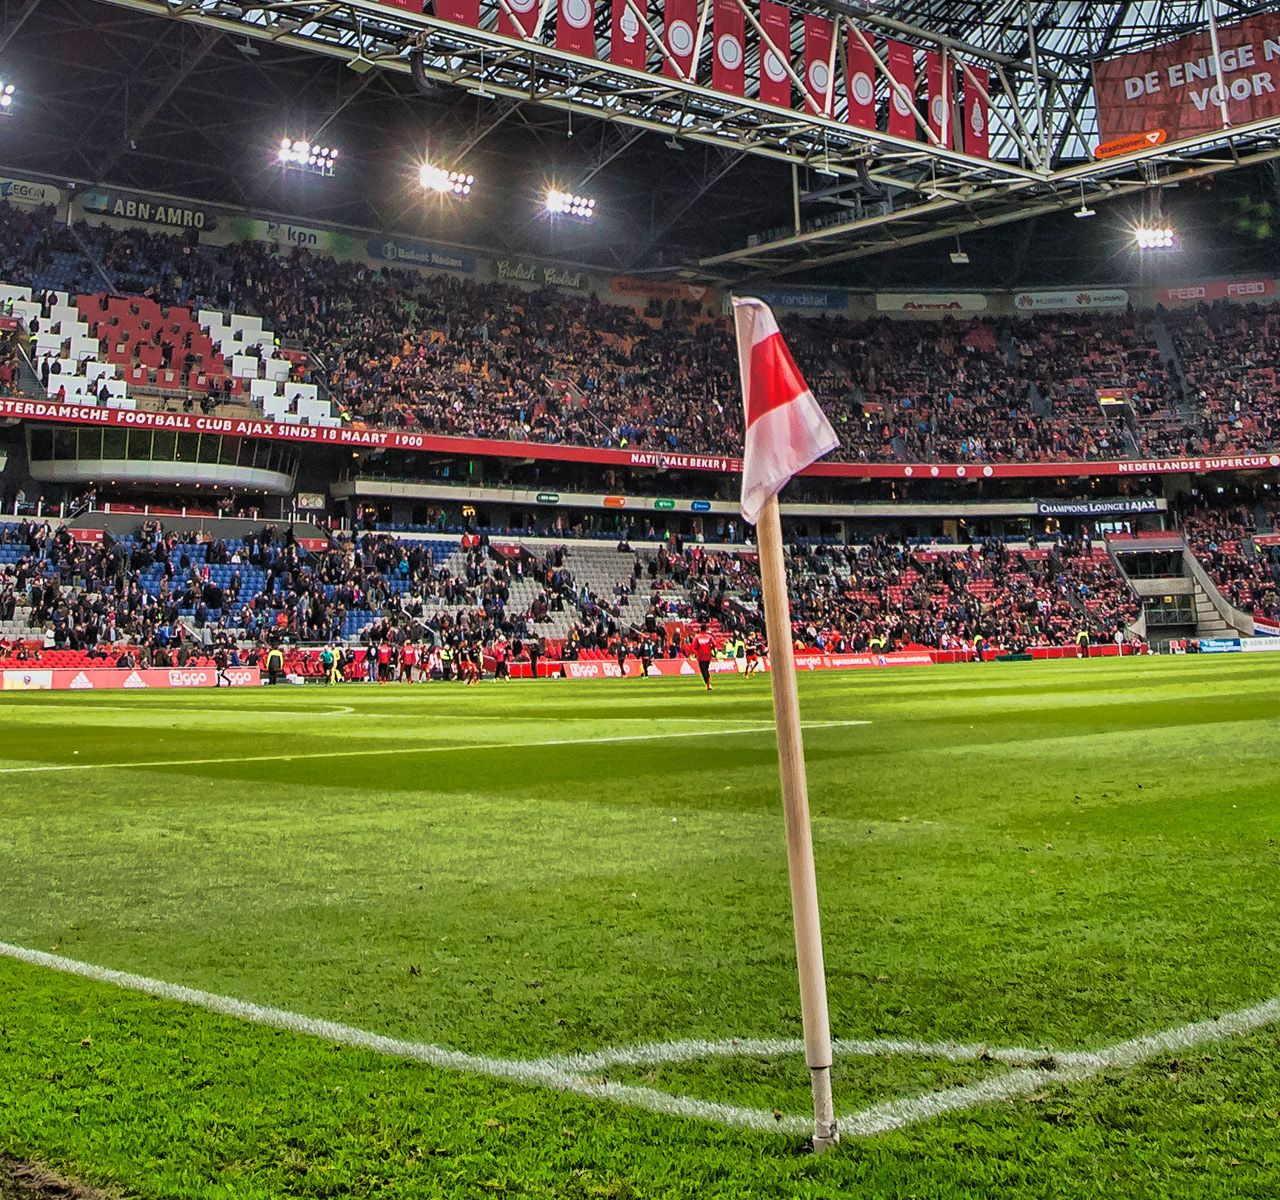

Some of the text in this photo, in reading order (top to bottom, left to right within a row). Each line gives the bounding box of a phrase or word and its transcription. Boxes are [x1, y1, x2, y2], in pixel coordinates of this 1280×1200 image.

[1123, 69, 1160, 100] DE
[1167, 44, 1255, 89] ENIGE
[1187, 70, 1275, 112] VOOR
[287, 225, 318, 246] kpn
[117, 411, 192, 428] FOOTBALL
[196, 418, 233, 432] CLUB
[236, 421, 274, 437] AJAX
[278, 425, 317, 439] SINDS
[322, 428, 337, 440] 18
[341, 430, 388, 445] MAART
[395, 435, 423, 448] 1900
[631, 453, 688, 468] NATINALE
[690, 457, 720, 469] BEKER
[1118, 457, 1267, 472] NEDERLANDSE SUPERCUP
[1040, 503, 1088, 513] CHAMPIONS
[1089, 501, 1126, 512] LOUNGE
[1130, 500, 1156, 512] AJAX
[168, 669, 207, 685] Ziggo
